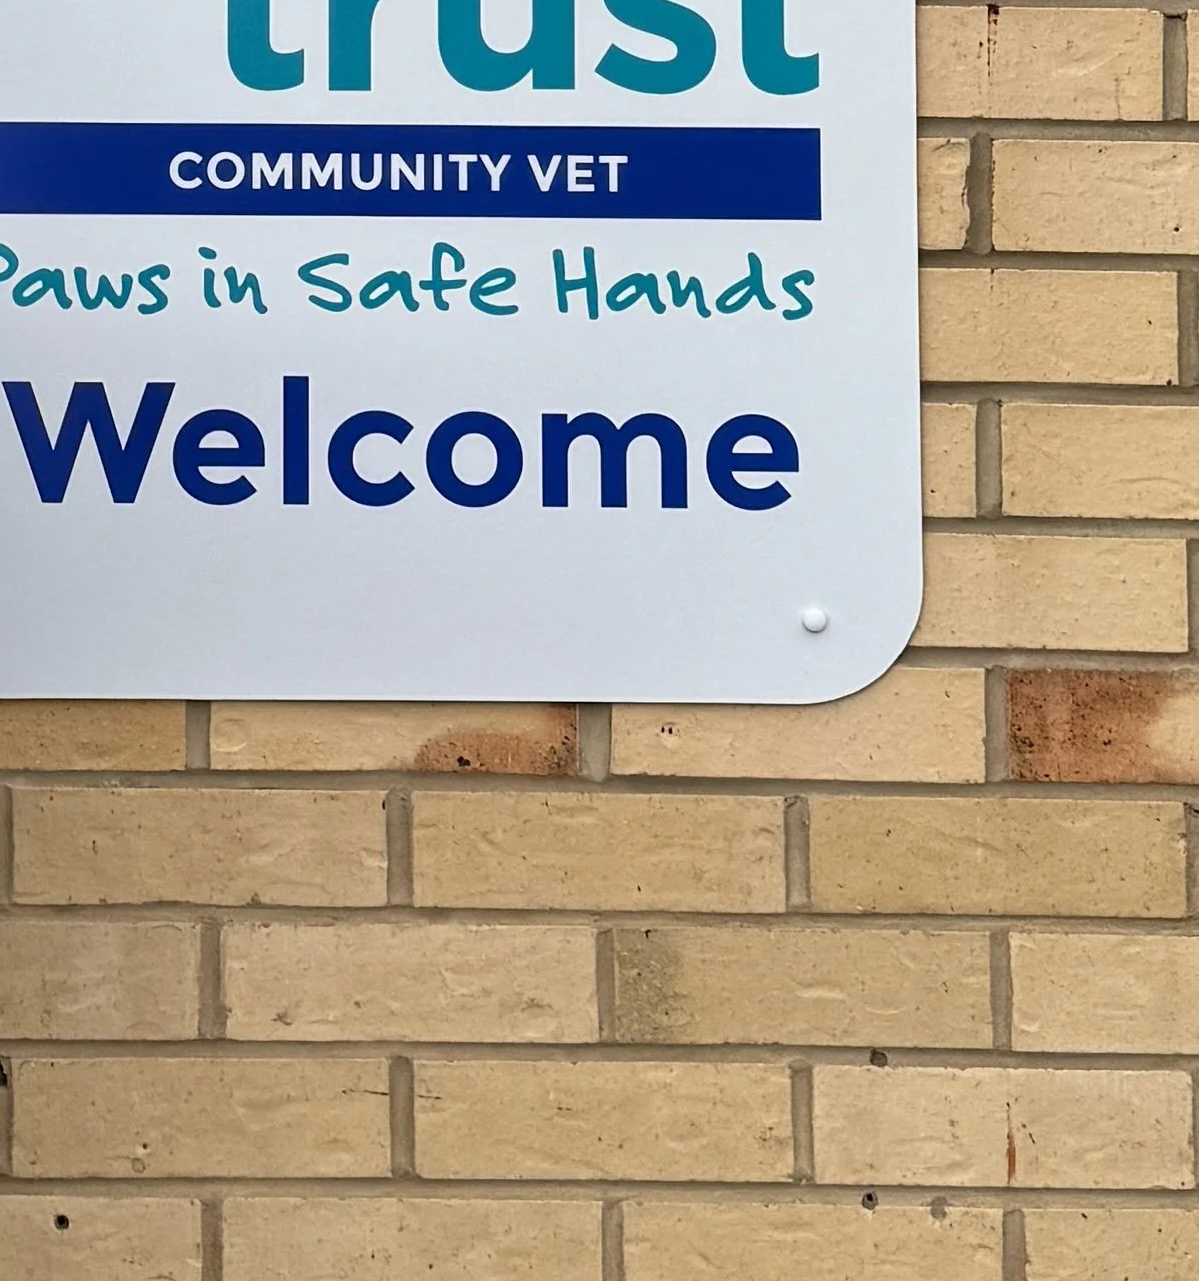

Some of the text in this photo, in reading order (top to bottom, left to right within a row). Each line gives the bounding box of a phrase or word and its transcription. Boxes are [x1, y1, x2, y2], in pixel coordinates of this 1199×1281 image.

[168, 151, 629, 194] COMMUNITY VET
[198, 246, 268, 316] in
[297, 241, 519, 317] Safe
[552, 246, 815, 321] Hands
[1, 375, 800, 511] Welcome
